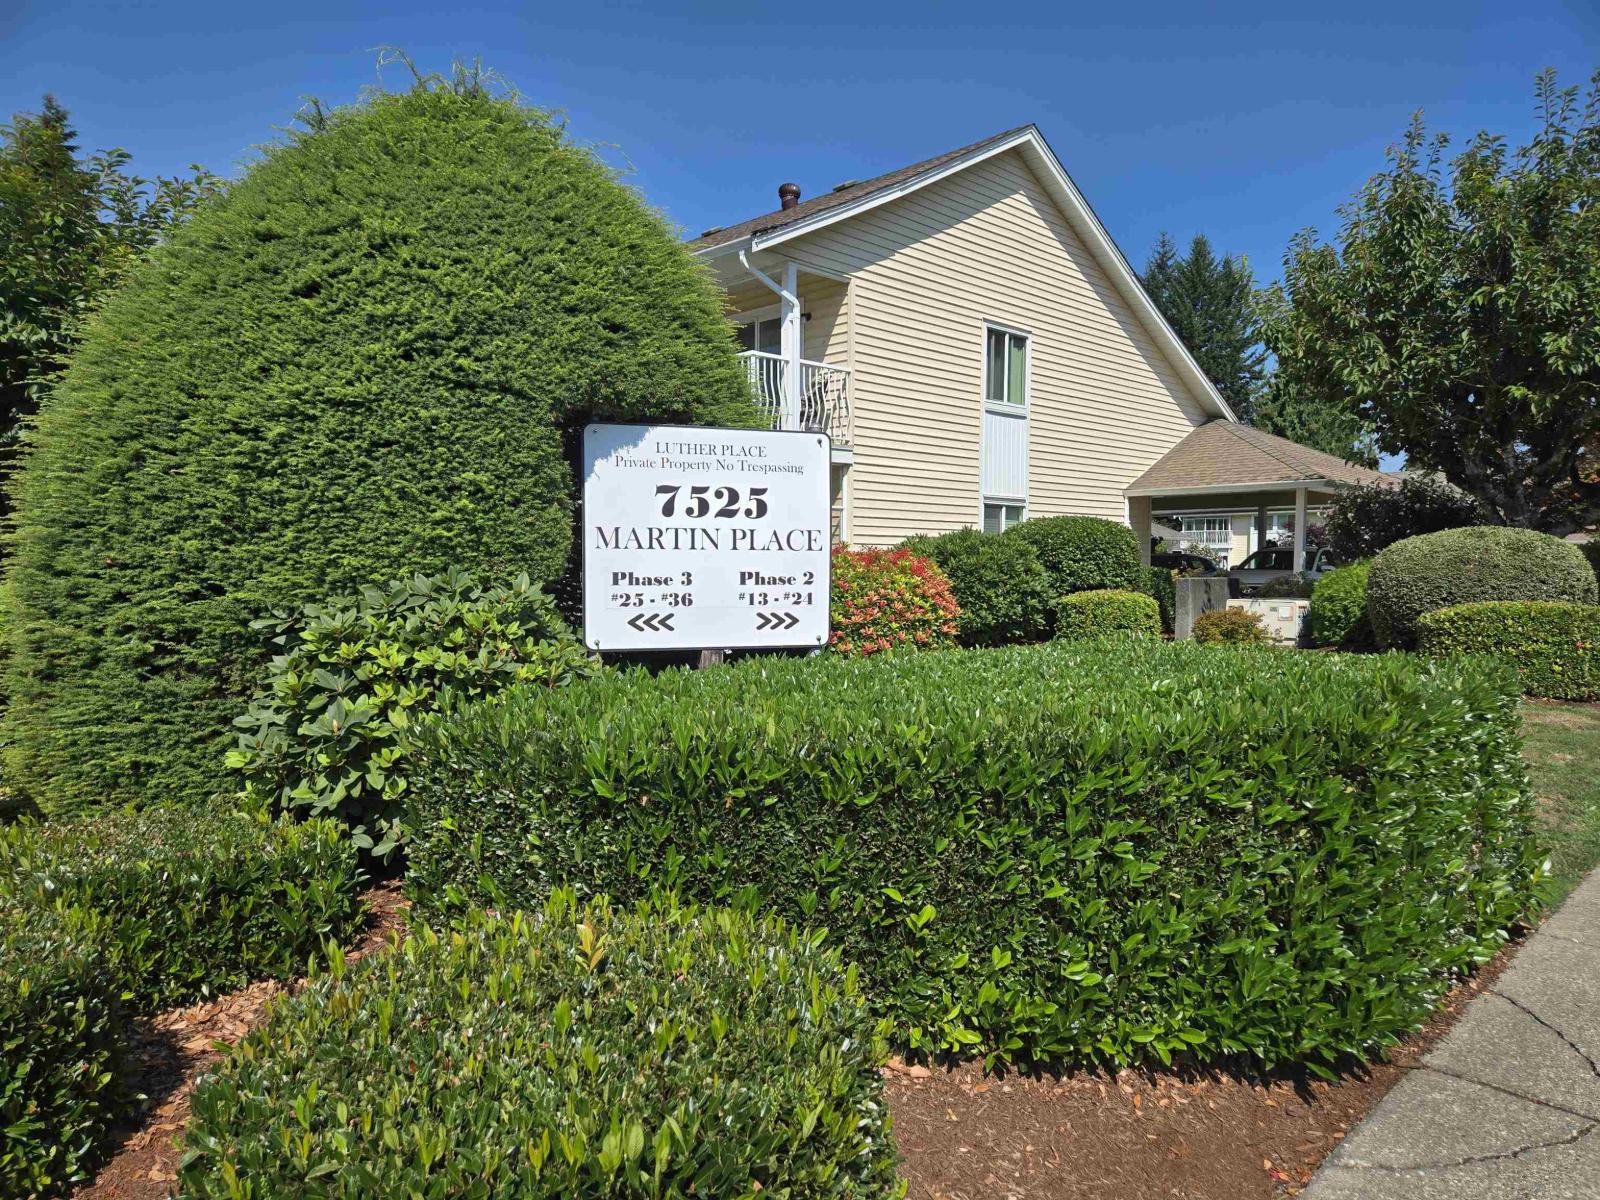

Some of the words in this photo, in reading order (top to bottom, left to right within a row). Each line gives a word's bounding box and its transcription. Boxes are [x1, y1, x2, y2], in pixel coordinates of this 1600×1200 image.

[656, 442, 717, 456] LUTHER
[721, 445, 767, 457] PLACE
[615, 456, 656, 468] Private
[661, 457, 710, 472] Property
[716, 459, 734, 471] No
[737, 460, 804, 475] Trespassing
[655, 484, 768, 519] 7525
[596, 527, 720, 550] MARTIN
[731, 529, 823, 551] PLACE
[611, 571, 673, 586] Phase
[681, 571, 692, 586] 3
[739, 571, 796, 585] Phase
[803, 571, 814, 585] 2
[611, 593, 644, 607] #25
[661, 593, 693, 606] #36
[739, 592, 768, 606] #13
[784, 592, 813, 605] #24
